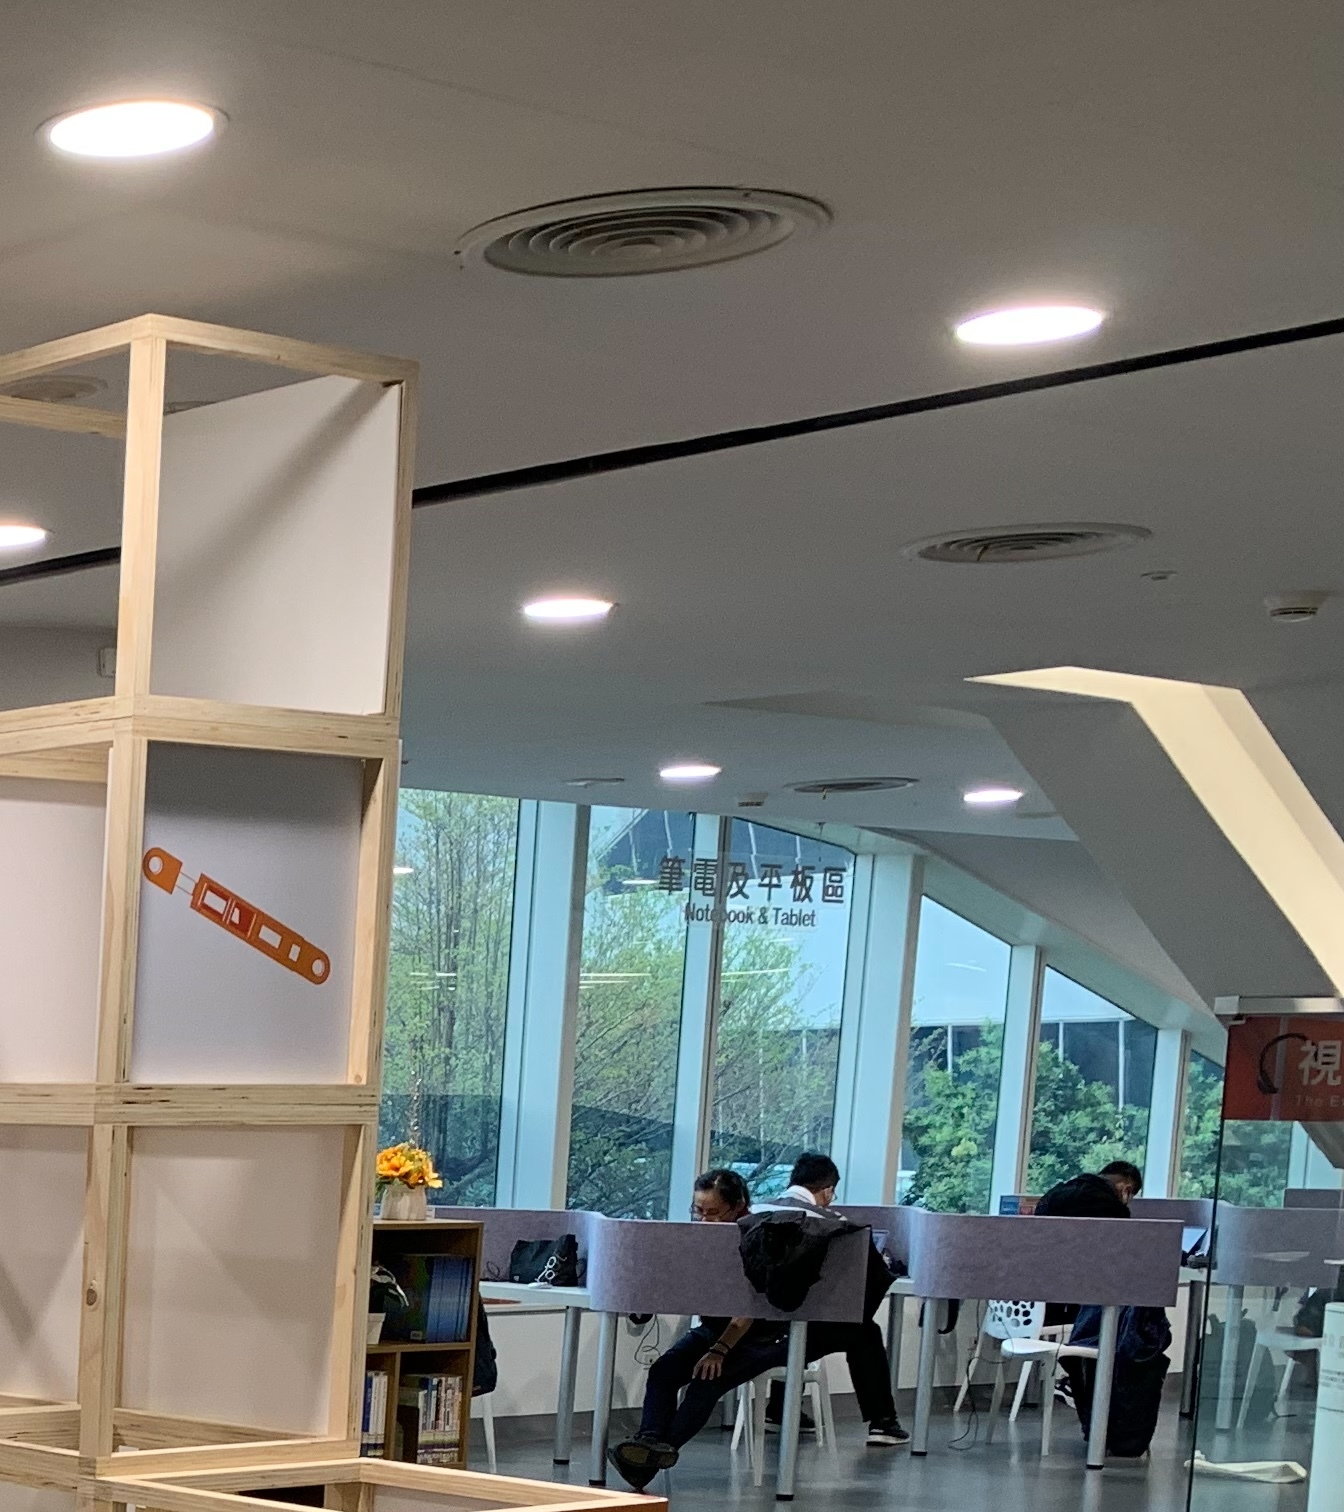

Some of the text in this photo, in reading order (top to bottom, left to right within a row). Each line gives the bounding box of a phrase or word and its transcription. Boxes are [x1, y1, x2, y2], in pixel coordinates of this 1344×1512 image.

[657, 855, 848, 904] 筆電及平板區
[773, 907, 816, 927] Tablet
